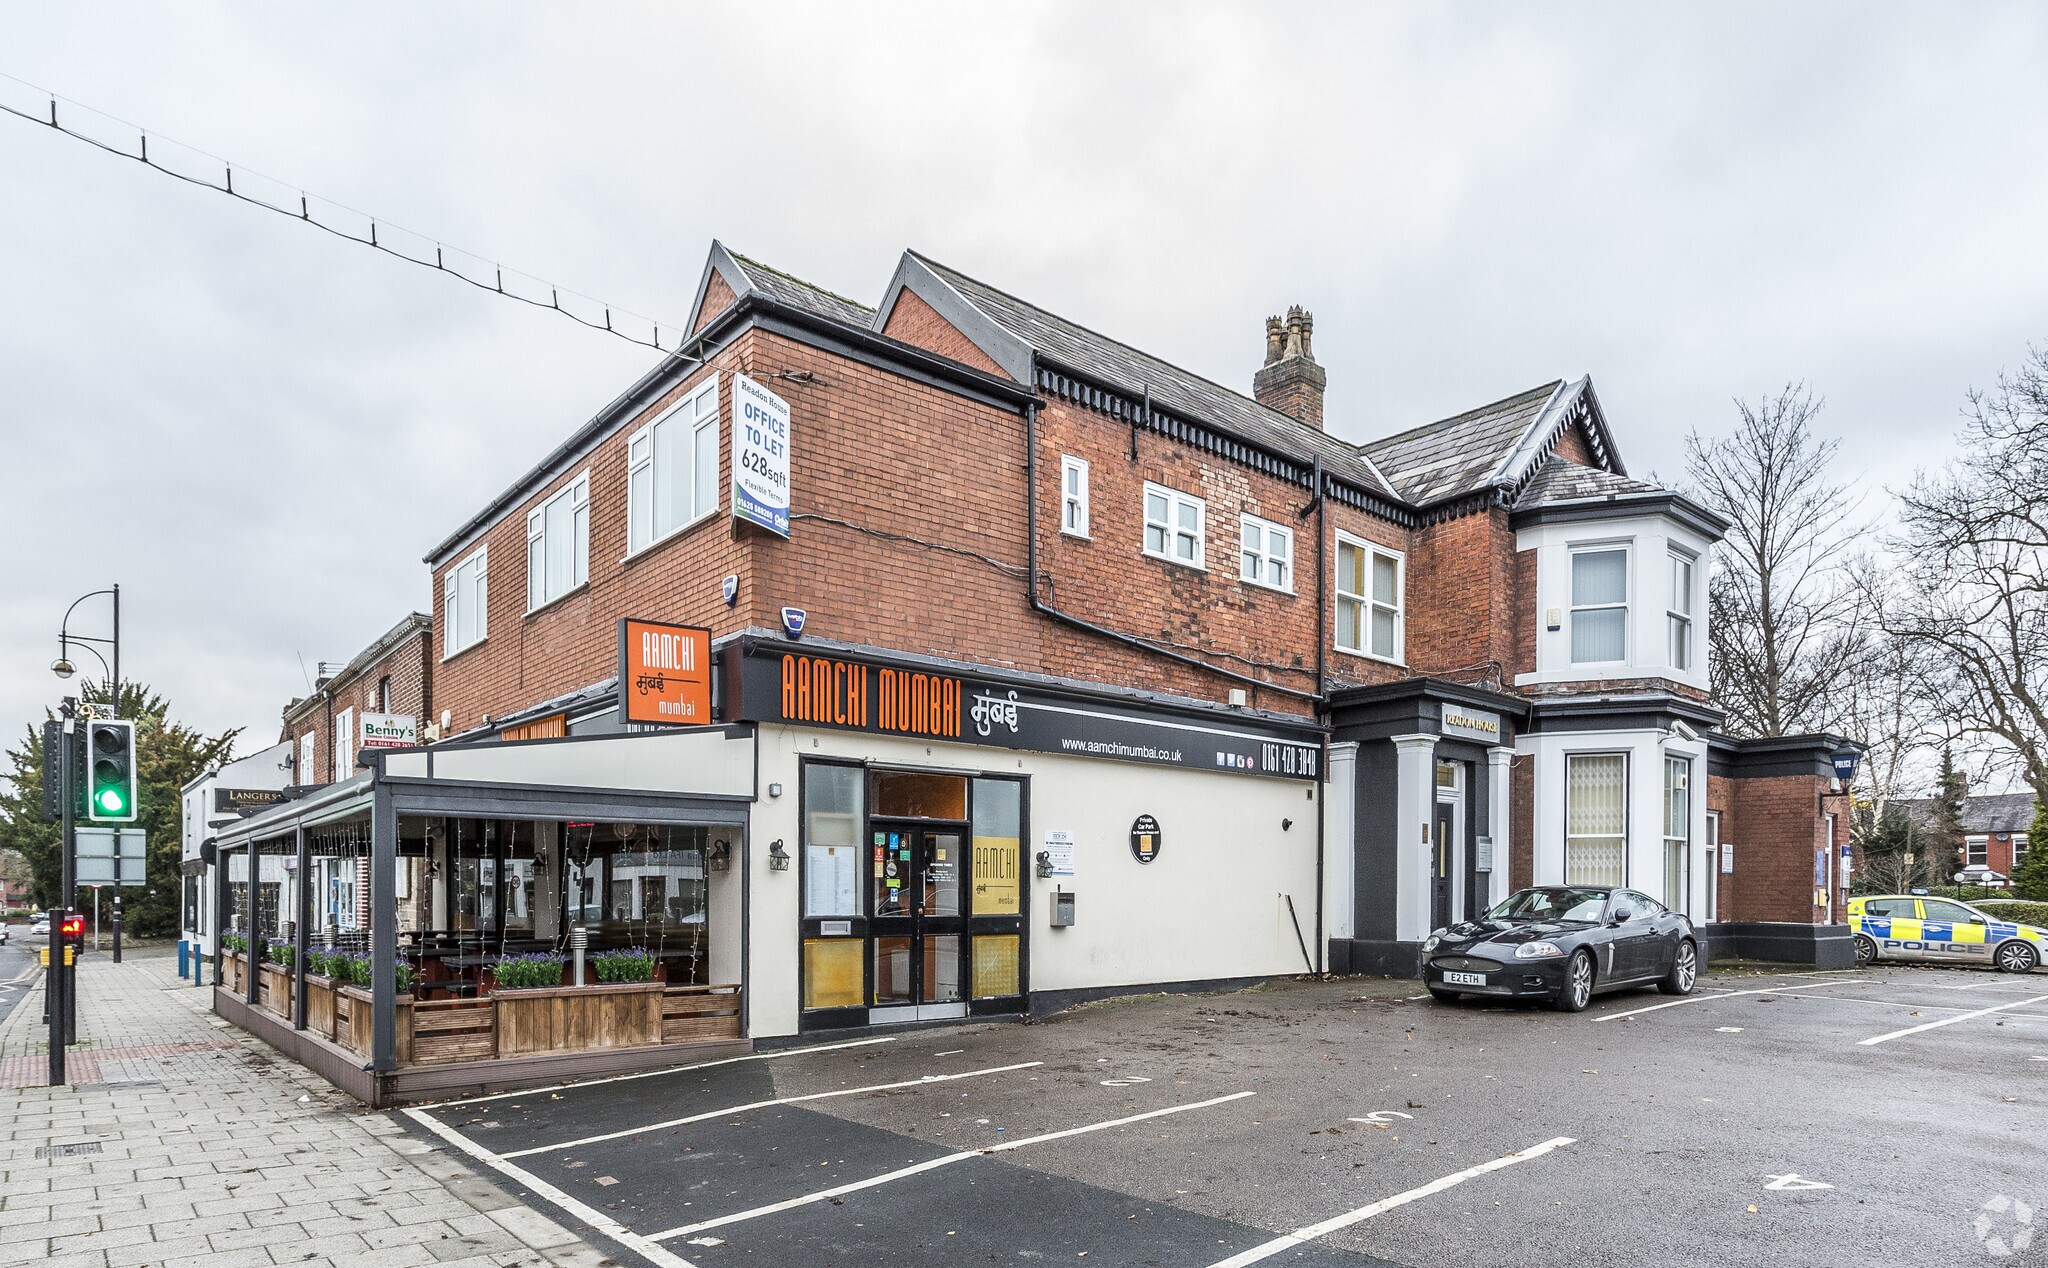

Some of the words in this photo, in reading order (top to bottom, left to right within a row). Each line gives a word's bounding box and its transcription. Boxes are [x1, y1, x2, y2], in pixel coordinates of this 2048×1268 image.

[741, 380, 768, 403] Readon
[768, 396, 788, 416] House
[744, 402, 785, 439] OFFICE
[745, 424, 761, 446] TO
[764, 434, 784, 459] LET
[744, 478, 767, 496] Flexible
[768, 489, 784, 504] Terms
[774, 514, 789, 529] Orbit
[642, 631, 695, 672] AAMCHI
[658, 692, 695, 716] mumbai
[780, 654, 867, 727] AAMCHI
[878, 668, 961, 738] MUMBAI
[970, 689, 1020, 737] मुंबई
[365, 723, 414, 739] Benny's
[1061, 738, 1182, 762] www.aamchimumbai.co.uk
[1262, 742, 1279, 772] 0161
[1281, 745, 1296, 774] 428
[1297, 747, 1316, 776] 3848
[1834, 759, 1852, 769] POLICE
[229, 789, 277, 801] LANGERS
[976, 847, 1015, 879] AAMCHI
[1883, 940, 1985, 955] POLICE
[1451, 973, 1462, 982] E2
[1462, 974, 1479, 984] ETH
